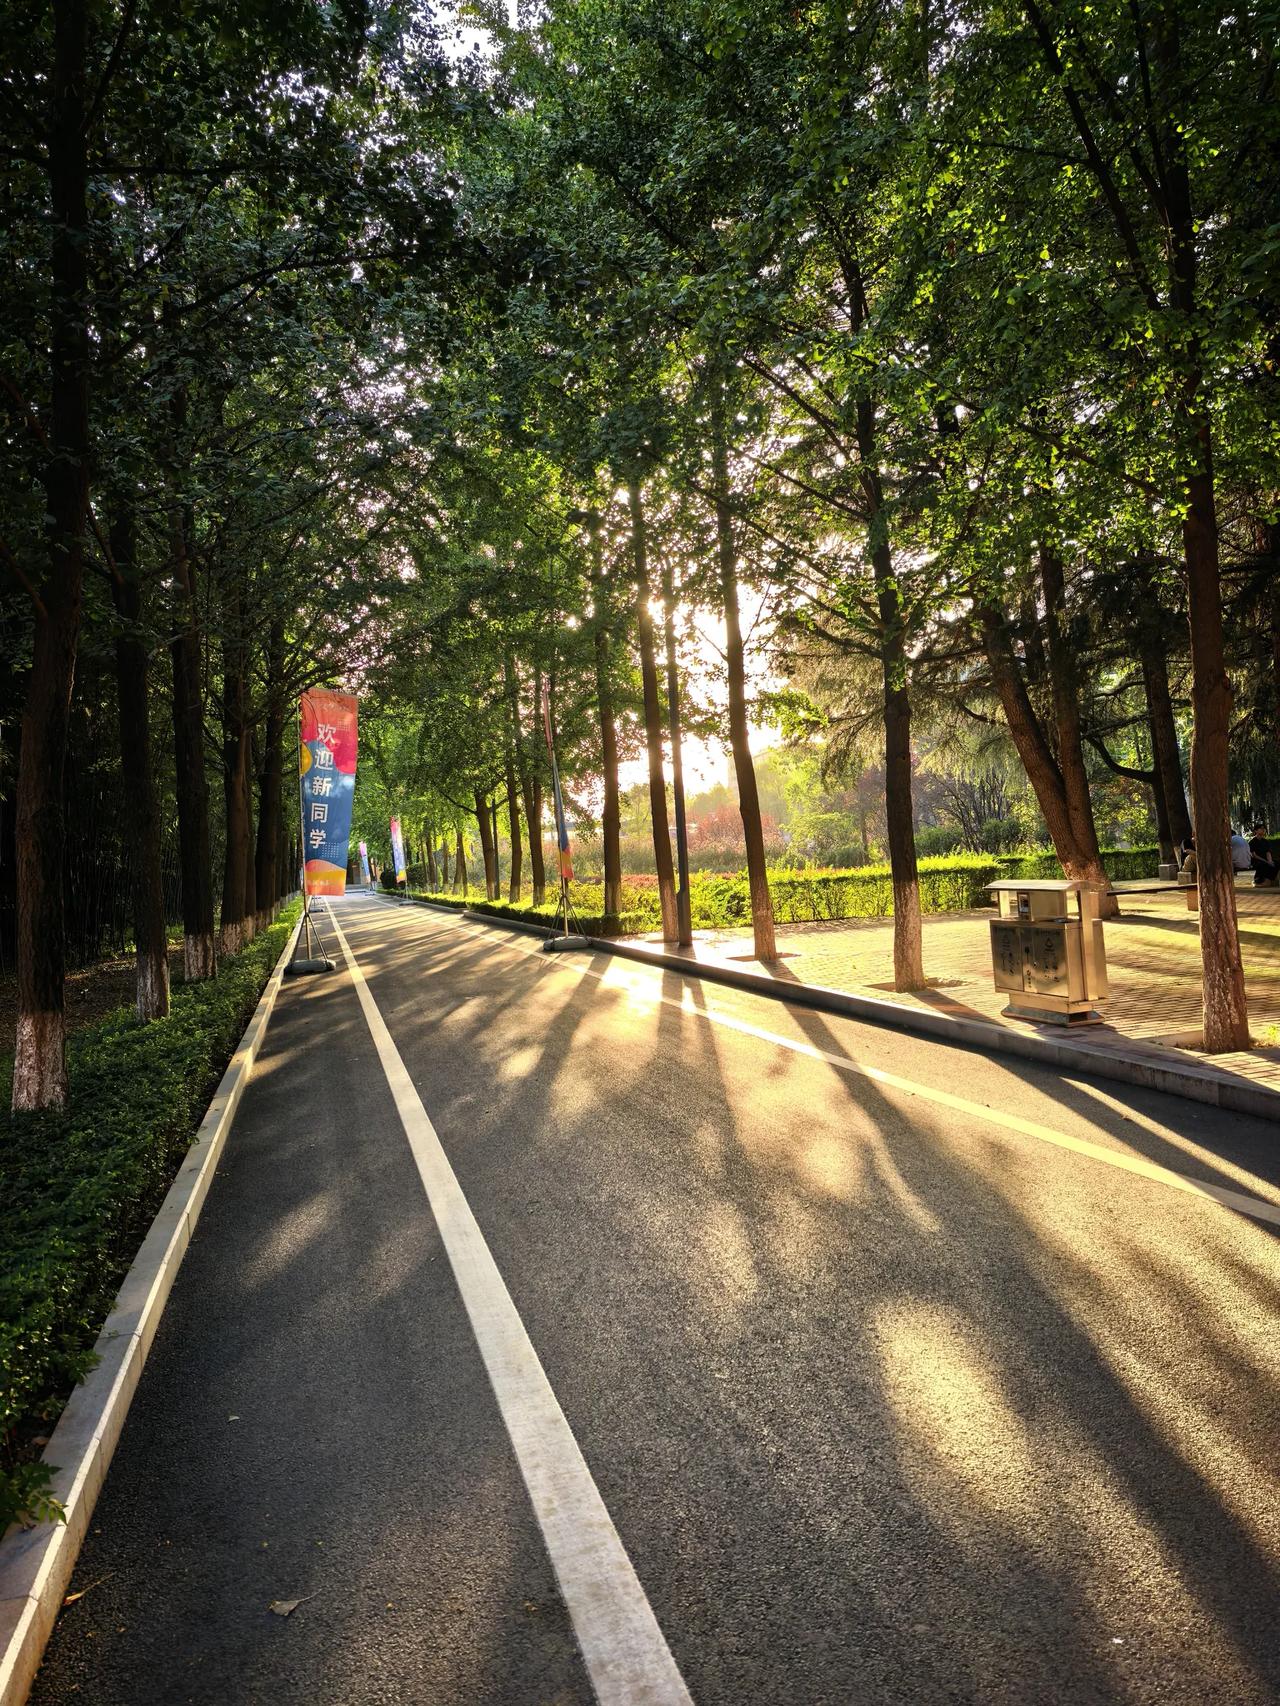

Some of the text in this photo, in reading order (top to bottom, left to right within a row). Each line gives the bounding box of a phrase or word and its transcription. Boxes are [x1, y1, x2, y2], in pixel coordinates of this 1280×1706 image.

[309, 723, 336, 849] 欢迎新同学
